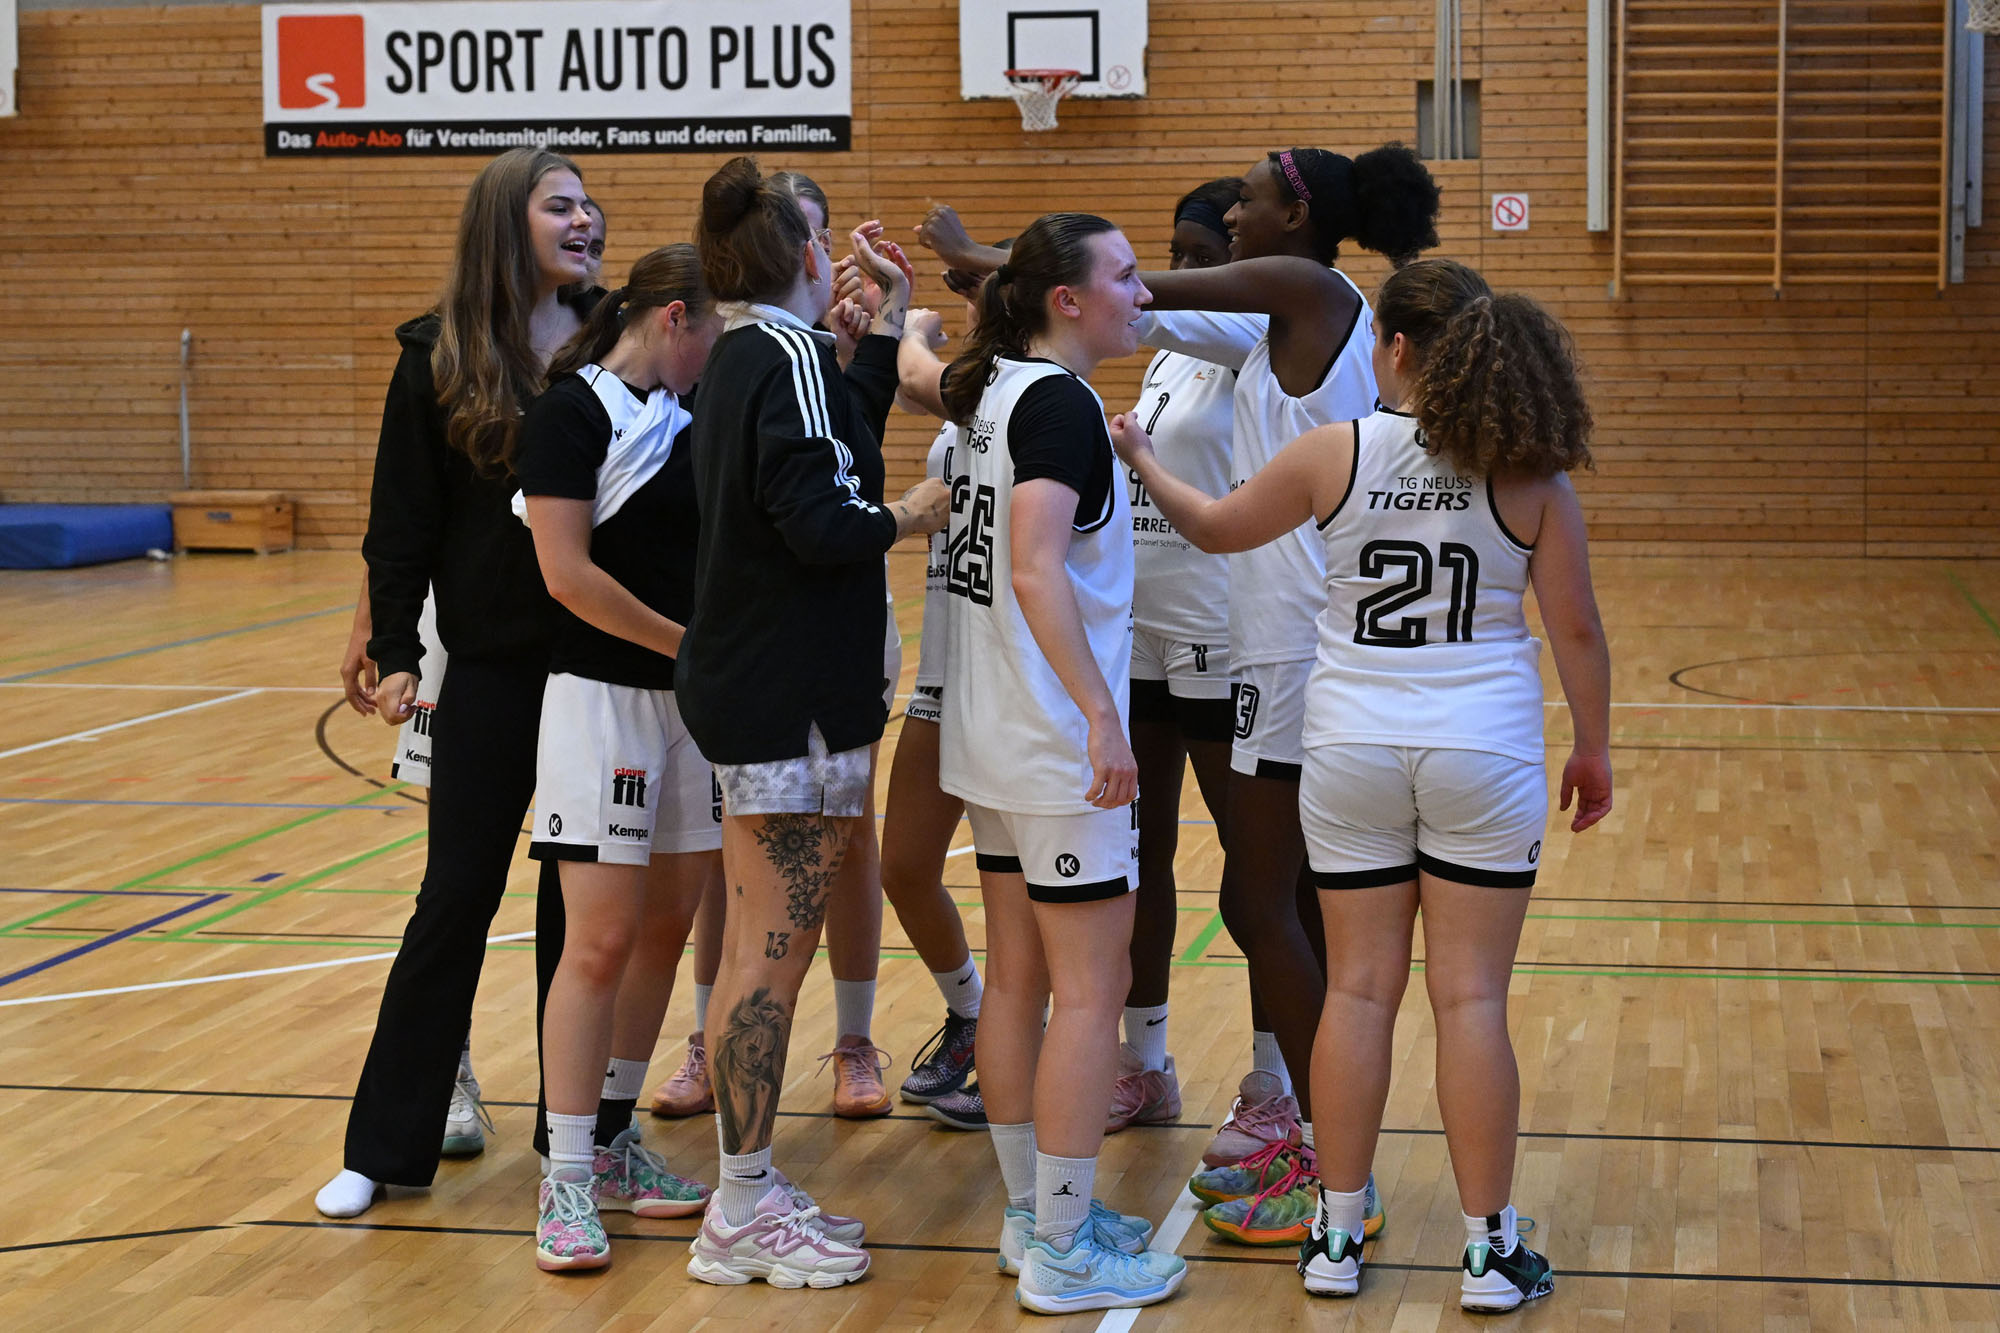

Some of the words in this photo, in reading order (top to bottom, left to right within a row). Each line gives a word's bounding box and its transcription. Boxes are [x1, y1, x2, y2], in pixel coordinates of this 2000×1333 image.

[385, 29, 544, 94] SPORT
[559, 26, 688, 92] AUTO
[711, 23, 836, 90] PLUS
[278, 131, 312, 148] Das
[315, 129, 402, 148] Auto-Abo
[406, 128, 434, 147] für
[436, 126, 603, 149] Vereinsmitglieder,
[607, 127, 650, 145] Fans
[655, 126, 690, 144] und
[694, 125, 747, 144] deren
[752, 124, 837, 143] Familien.
[1398, 477, 1417, 489] TG
[1423, 476, 1473, 489] NEUSS
[1368, 491, 1471, 511] TIGERS
[948, 474, 995, 607] 25
[1353, 540, 1479, 648] 21
[406, 749, 432, 767] Kemp
[614, 768, 646, 777] clever
[613, 775, 646, 808] fit
